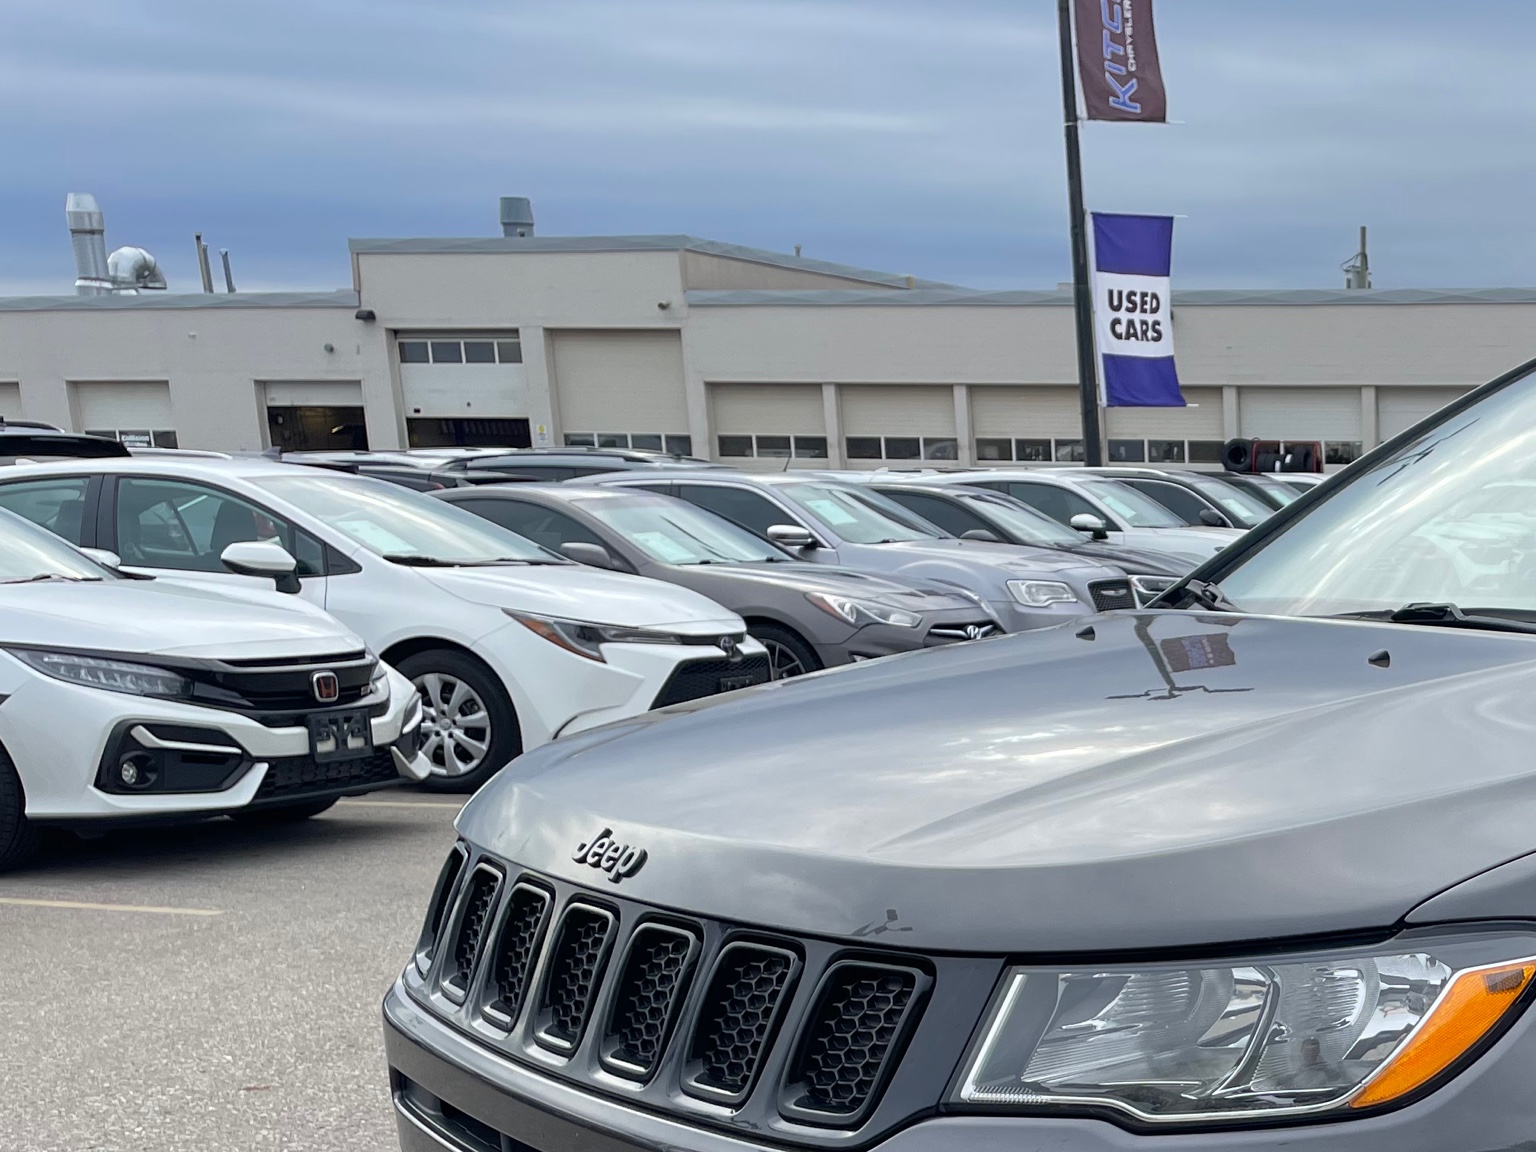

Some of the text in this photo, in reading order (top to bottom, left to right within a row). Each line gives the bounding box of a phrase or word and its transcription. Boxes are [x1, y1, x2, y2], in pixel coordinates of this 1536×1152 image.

[1100, 0, 1141, 113] KITC
[1107, 288, 1160, 314] USED
[1109, 317, 1163, 342] CARS
[571, 827, 648, 884] Jeep
